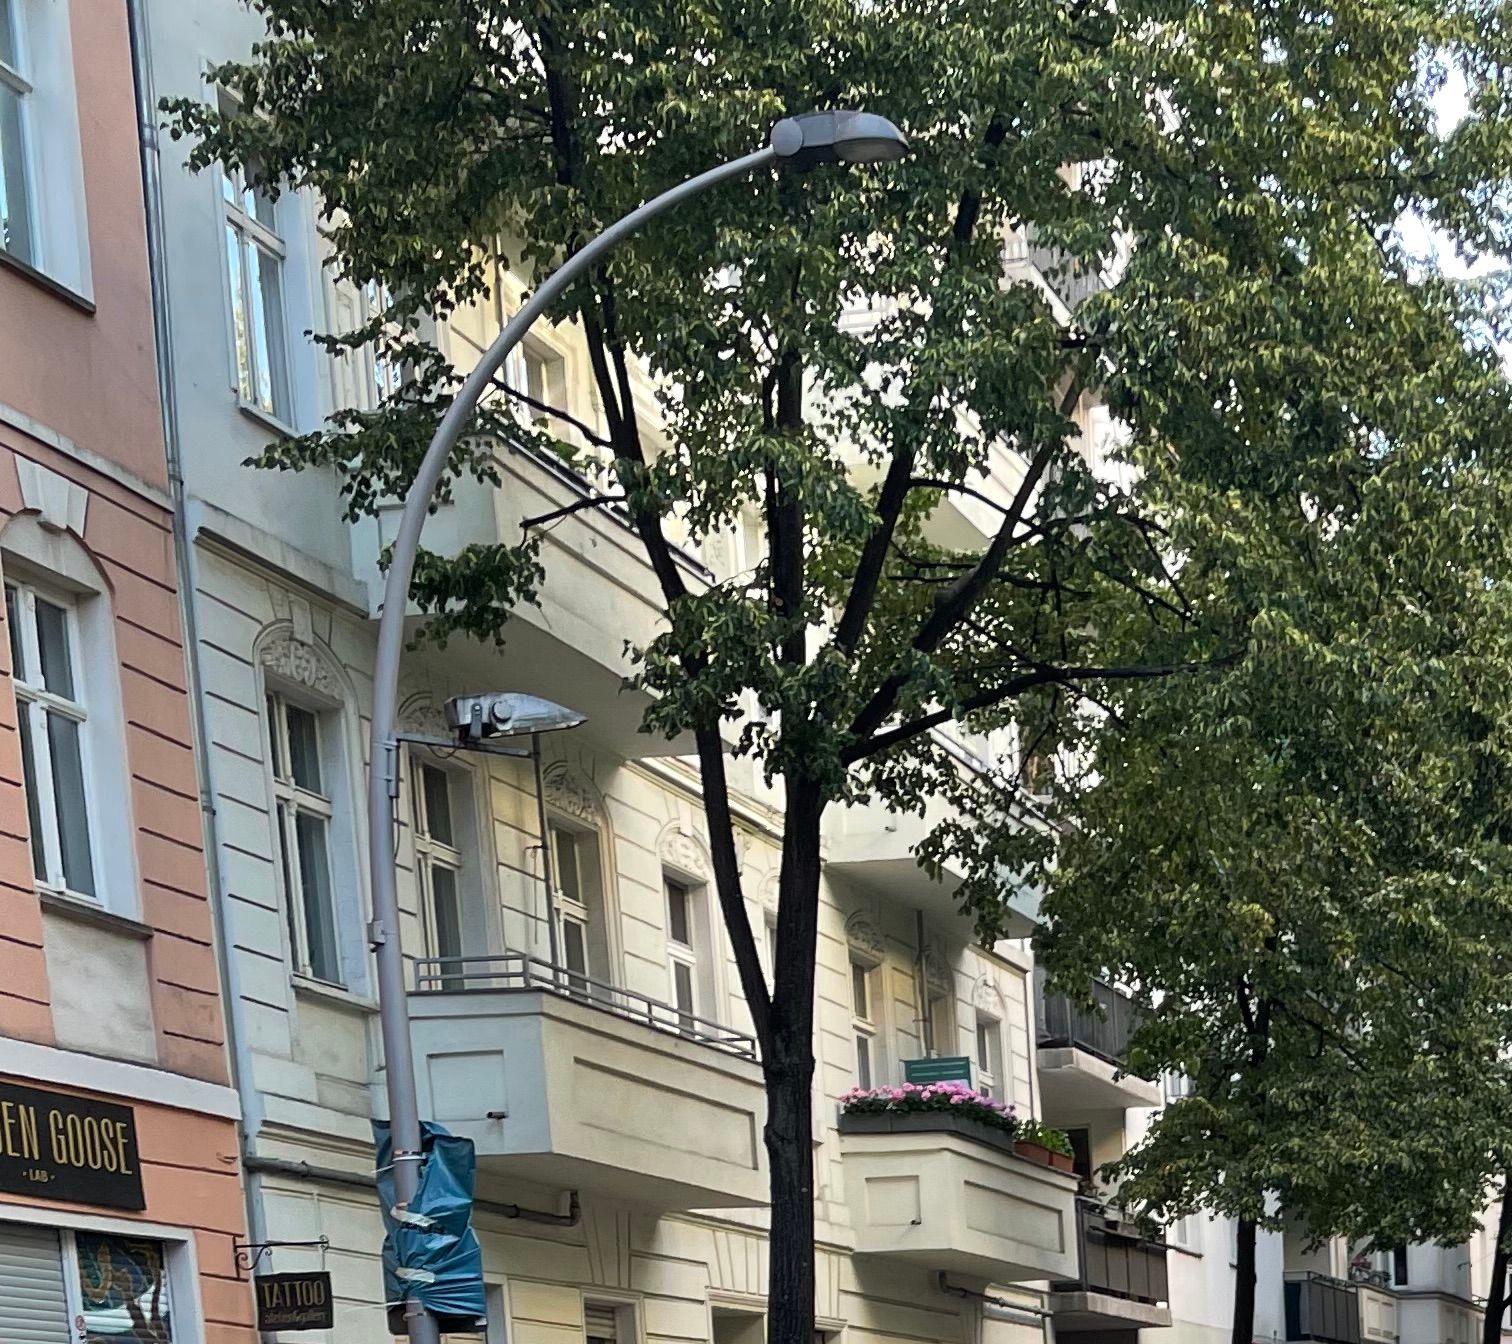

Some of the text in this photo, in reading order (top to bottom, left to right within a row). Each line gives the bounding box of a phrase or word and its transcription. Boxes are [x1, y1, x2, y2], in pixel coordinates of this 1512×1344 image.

[0, 1101, 133, 1175] EN GOOSE
[262, 1280, 325, 1309] TATTOO
